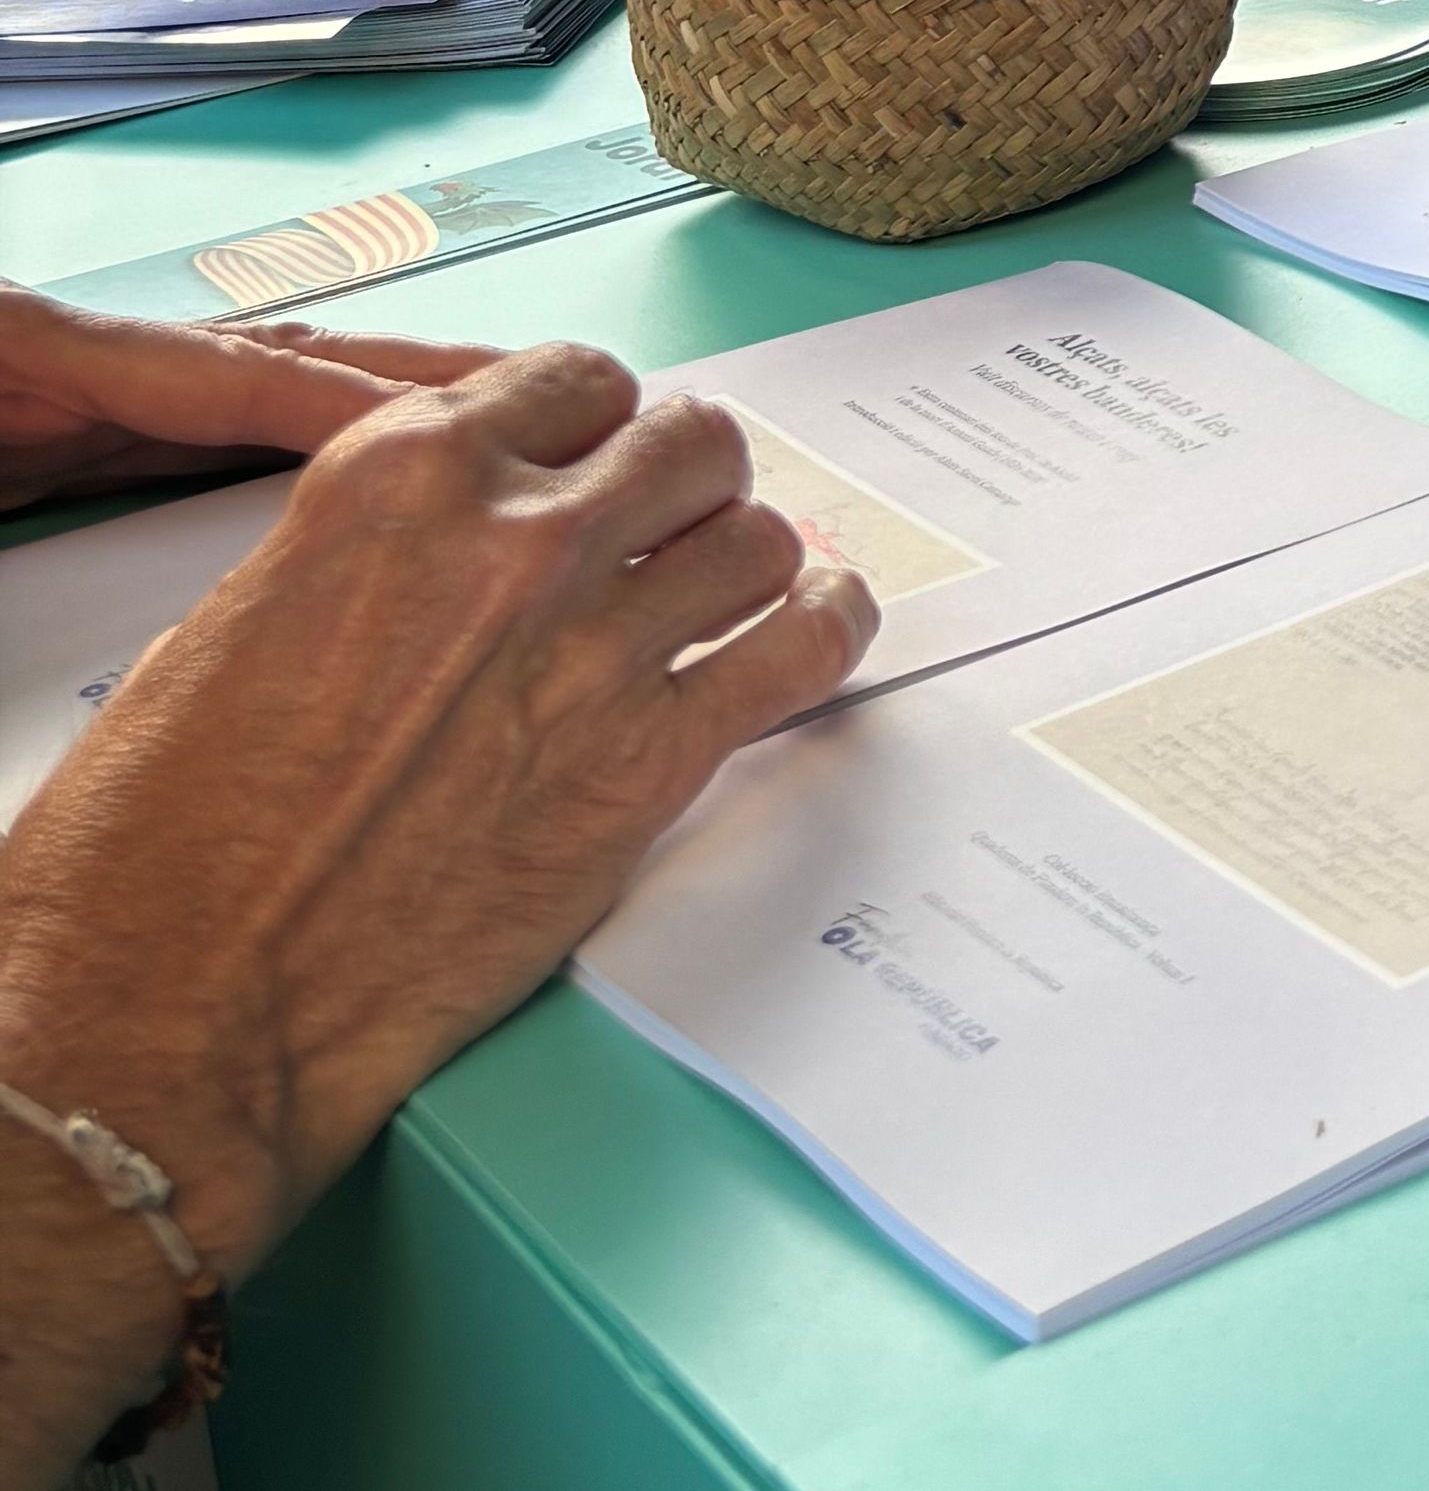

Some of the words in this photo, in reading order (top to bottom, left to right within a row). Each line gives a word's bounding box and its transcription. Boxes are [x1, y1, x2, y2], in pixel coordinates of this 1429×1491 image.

[1005, 343, 1082, 389] vostres
[1080, 384, 1208, 453] banderes!
[1046, 333, 1122, 380] Alçats,
[1125, 375, 1202, 419] alçats
[1192, 412, 1238, 437] les
